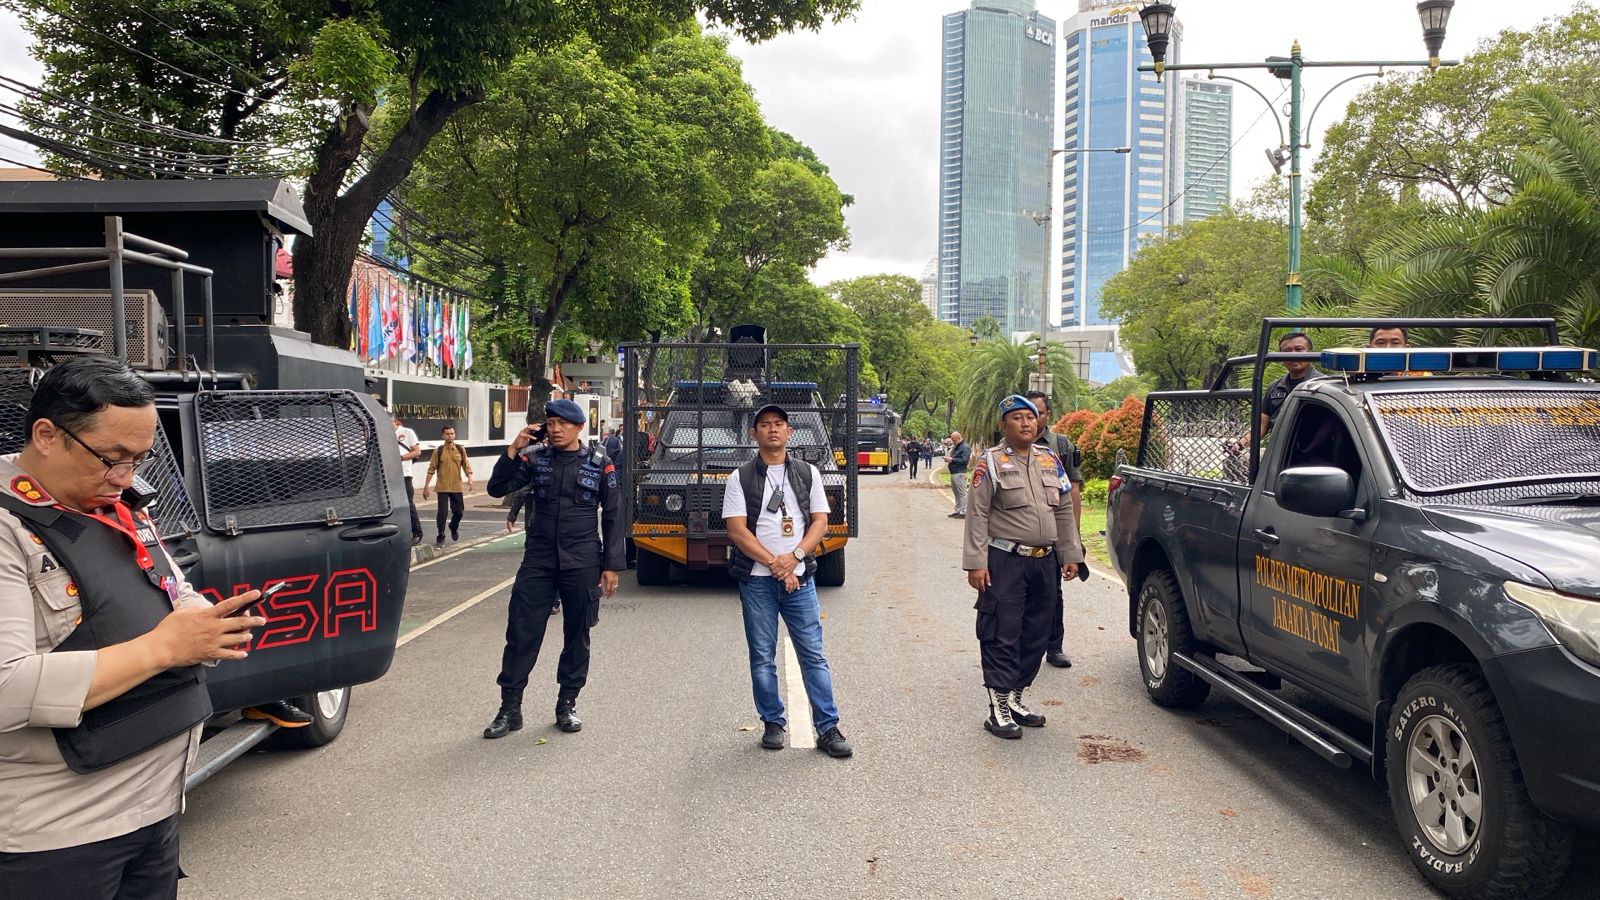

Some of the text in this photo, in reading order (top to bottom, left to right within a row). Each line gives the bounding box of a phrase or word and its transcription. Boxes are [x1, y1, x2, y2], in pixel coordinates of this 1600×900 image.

[1035, 28, 1053, 46] BCA
[136, 528, 155, 542] DRI
[41, 554, 63, 574] A
[1255, 554, 1360, 620] POLRES METROPOLITAN
[1273, 597, 1341, 655] JAKARTA PUSAT
[1395, 696, 1437, 742] SAVERO
[1413, 835, 1480, 873] GT RADIAL
